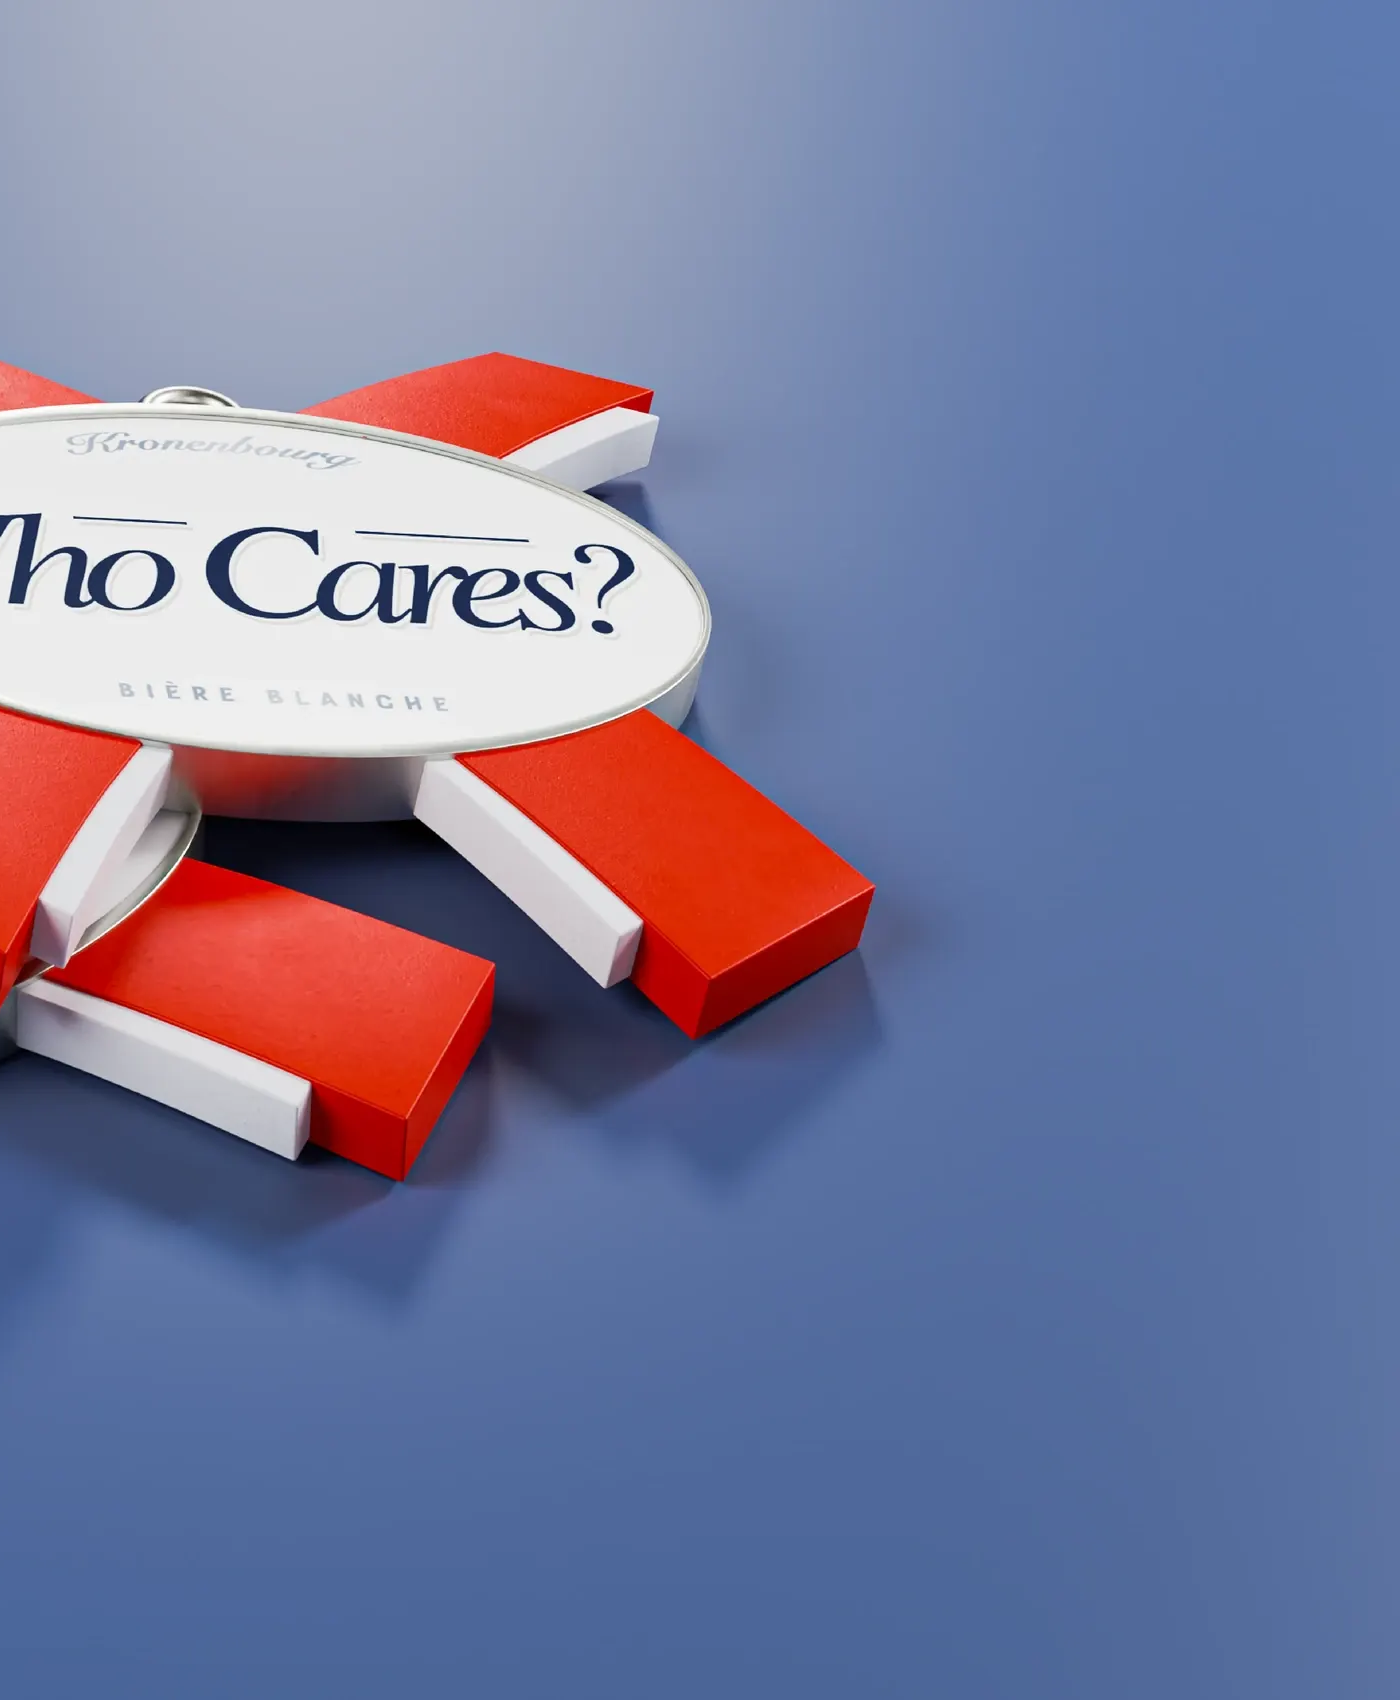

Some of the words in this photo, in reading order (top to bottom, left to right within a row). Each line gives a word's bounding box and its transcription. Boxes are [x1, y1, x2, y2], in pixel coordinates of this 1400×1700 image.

[65, 430, 362, 470] Kronenbourg
[204, 525, 636, 636] Cares?
[117, 680, 236, 703] BIÈRE
[265, 688, 449, 713] BLANCHE
